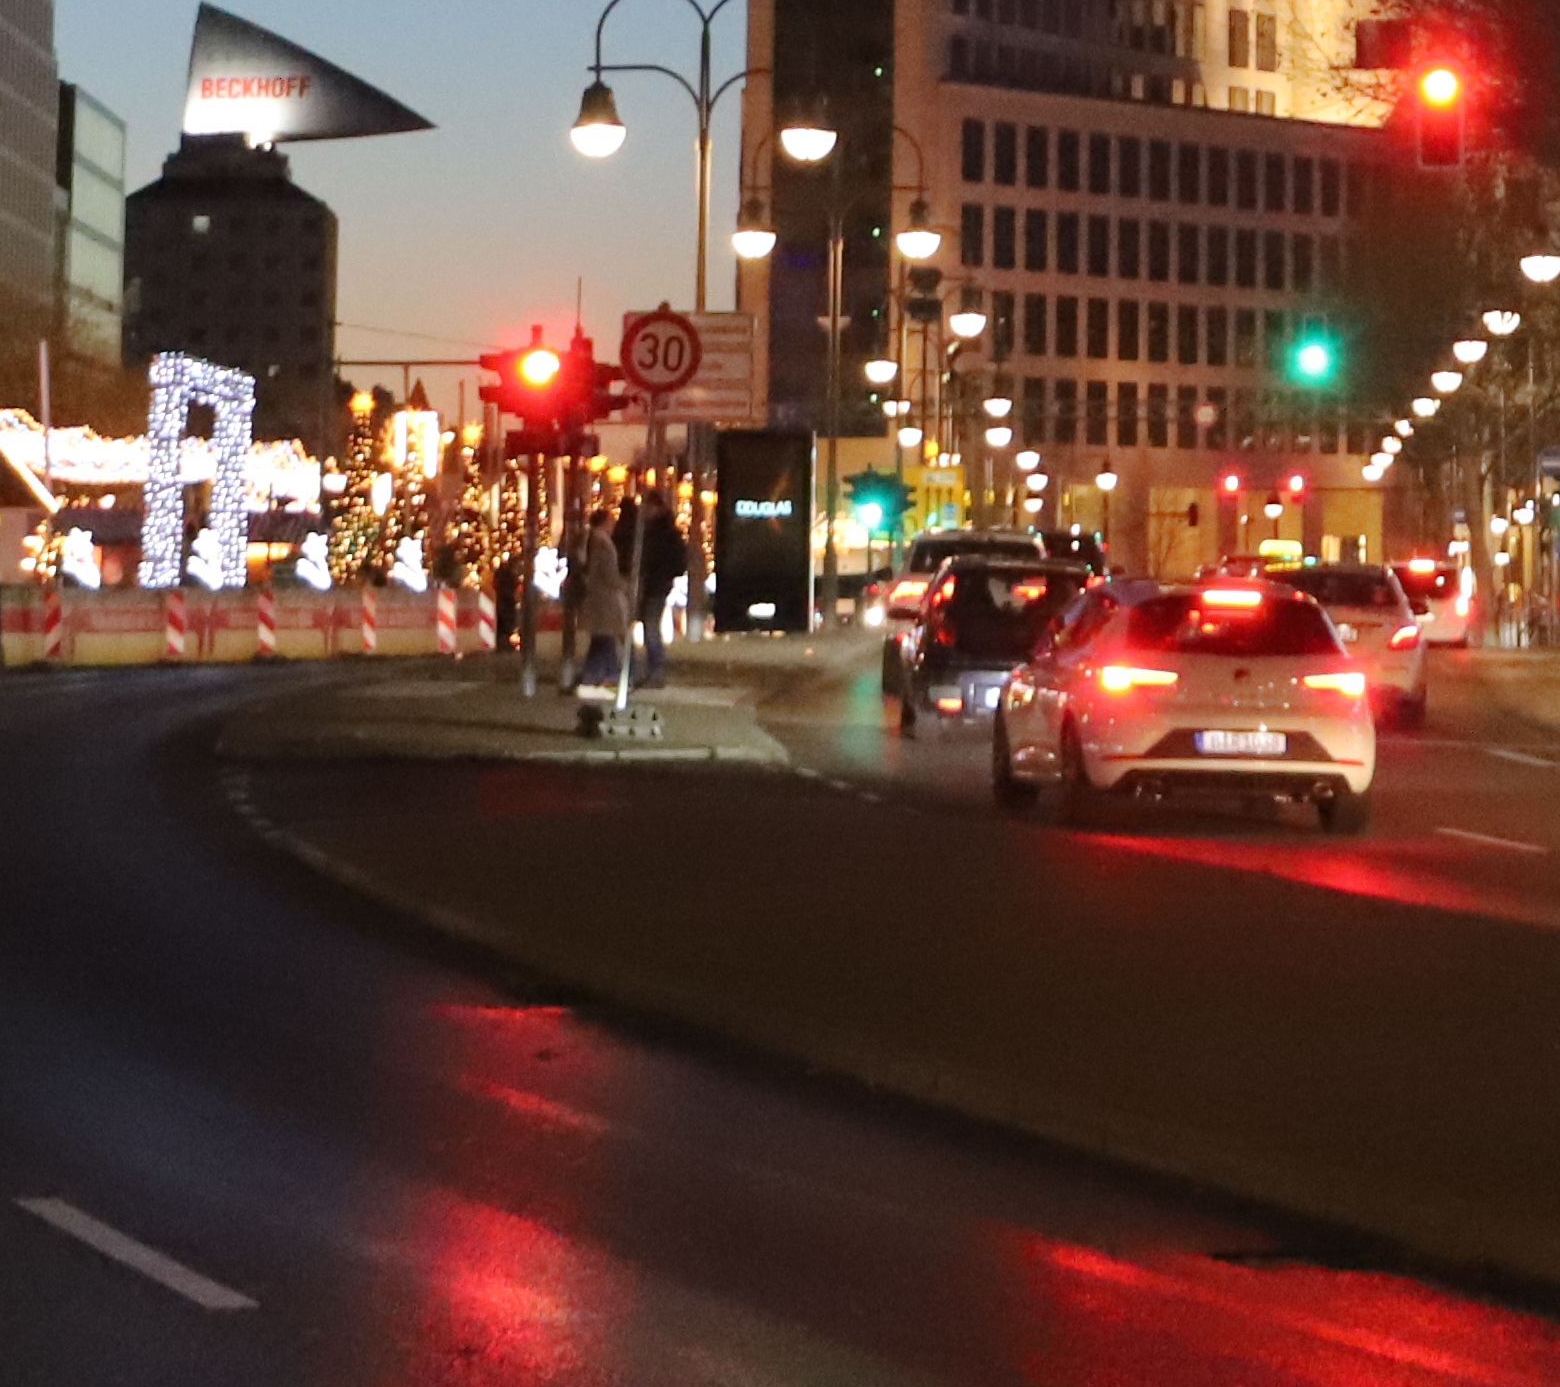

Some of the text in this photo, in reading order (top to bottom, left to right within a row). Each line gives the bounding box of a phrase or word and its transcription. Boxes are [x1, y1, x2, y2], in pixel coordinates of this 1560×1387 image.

[201, 75, 311, 100] BECKHOFF
[638, 332, 685, 373] 30
[735, 499, 792, 518] DOUGLAS
